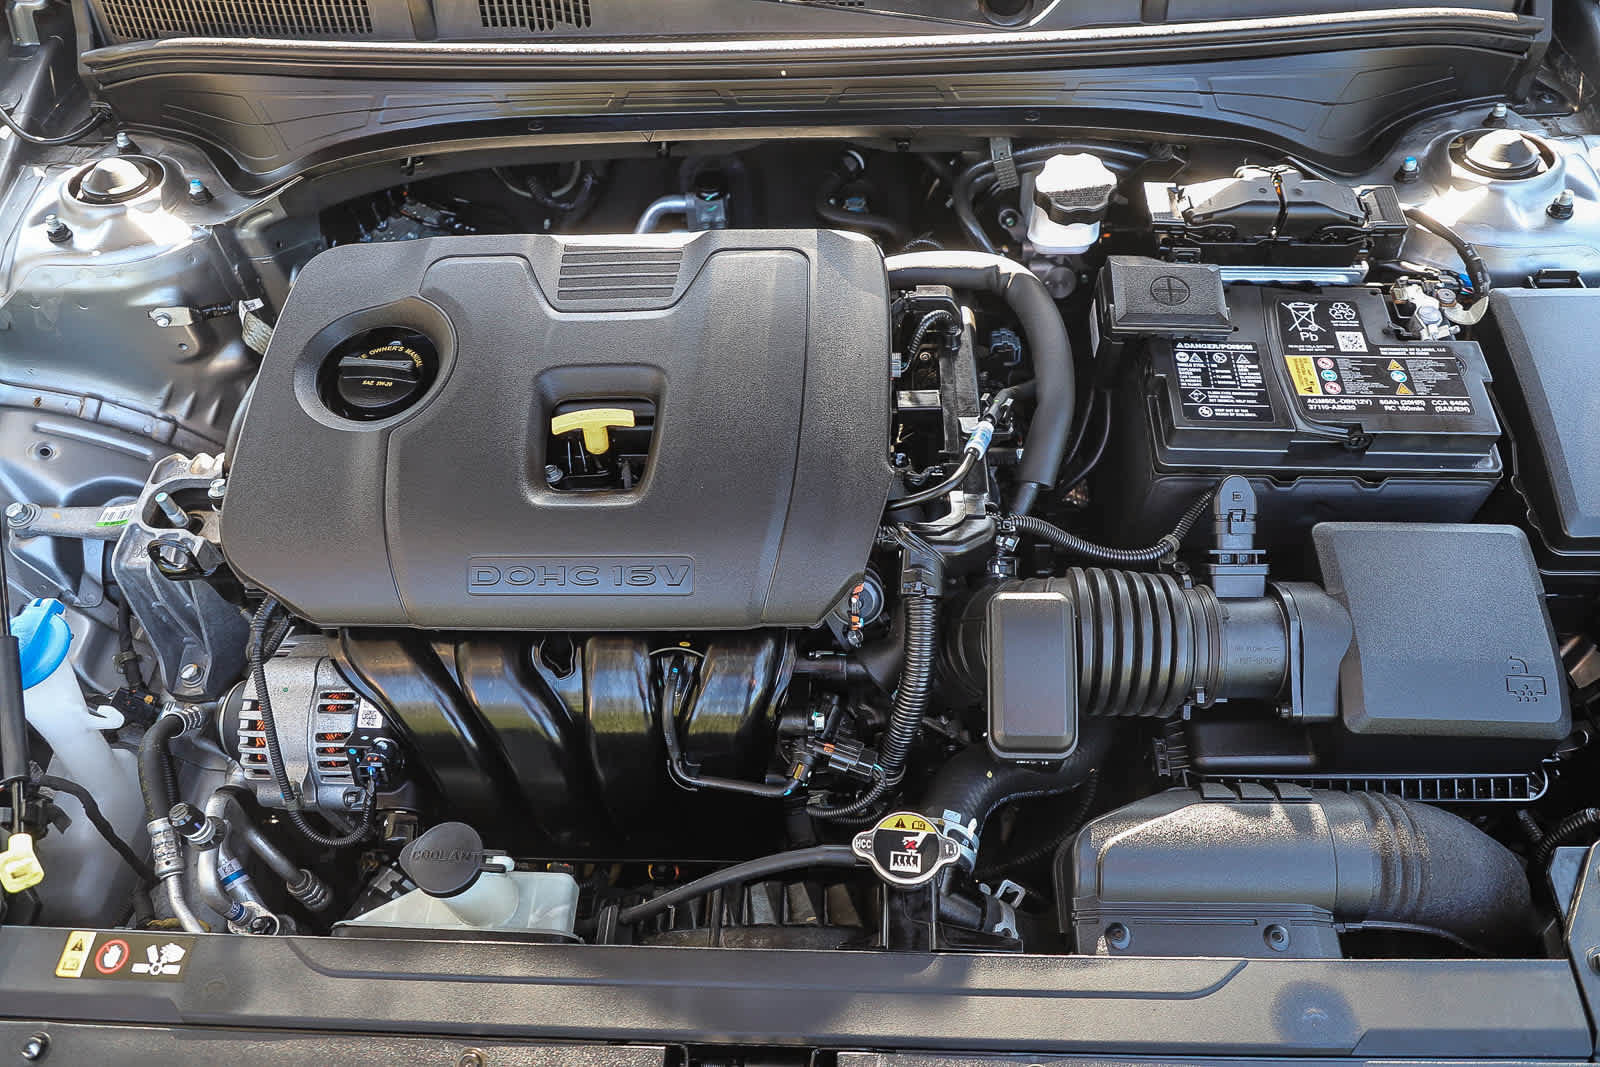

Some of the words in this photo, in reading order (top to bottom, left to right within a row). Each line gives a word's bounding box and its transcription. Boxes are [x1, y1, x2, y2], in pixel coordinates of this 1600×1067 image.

[1300, 332, 1319, 341] Pb
[369, 345, 404, 355] OWNER'S
[405, 348, 423, 368] MANUAL
[471, 565, 600, 586] DOHC
[610, 564, 691, 586] 16V
[855, 837, 872, 849] HCC
[945, 843, 957, 855] 1.1
[411, 847, 479, 863] COOLANT
